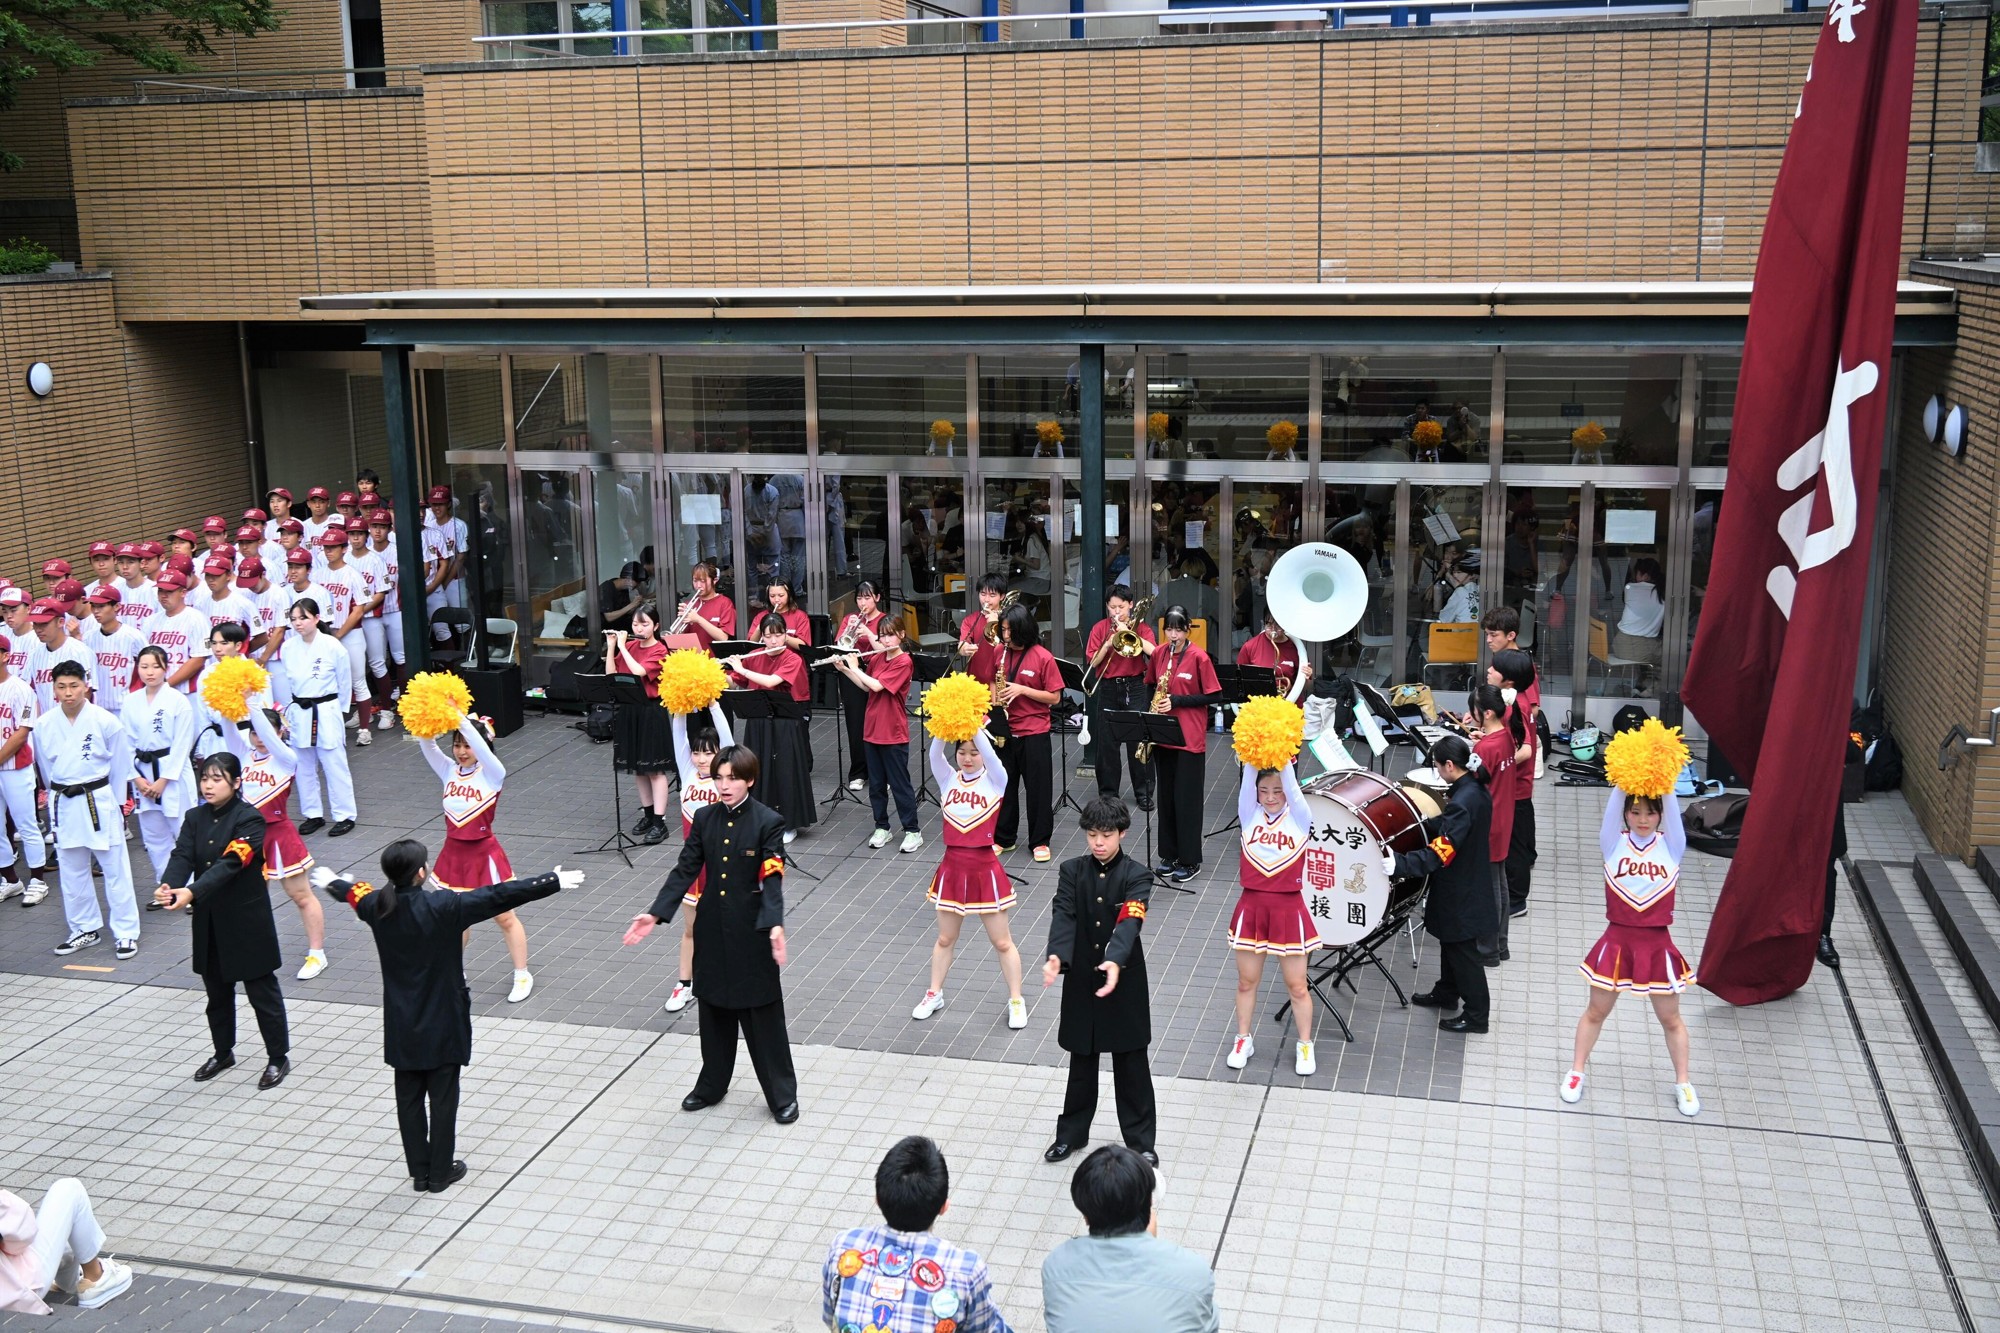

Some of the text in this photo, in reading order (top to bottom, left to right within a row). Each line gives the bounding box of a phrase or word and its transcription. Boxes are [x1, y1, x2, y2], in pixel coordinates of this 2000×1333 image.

[1314, 548, 1338, 560] YAMAHA
[148, 631, 187, 648] Meijo
[110, 675, 127, 687] 14
[443, 781, 482, 802] Leaps
[943, 788, 988, 810] Leaps
[1247, 825, 1295, 850] Leaps
[1613, 857, 1668, 882] Leaps
